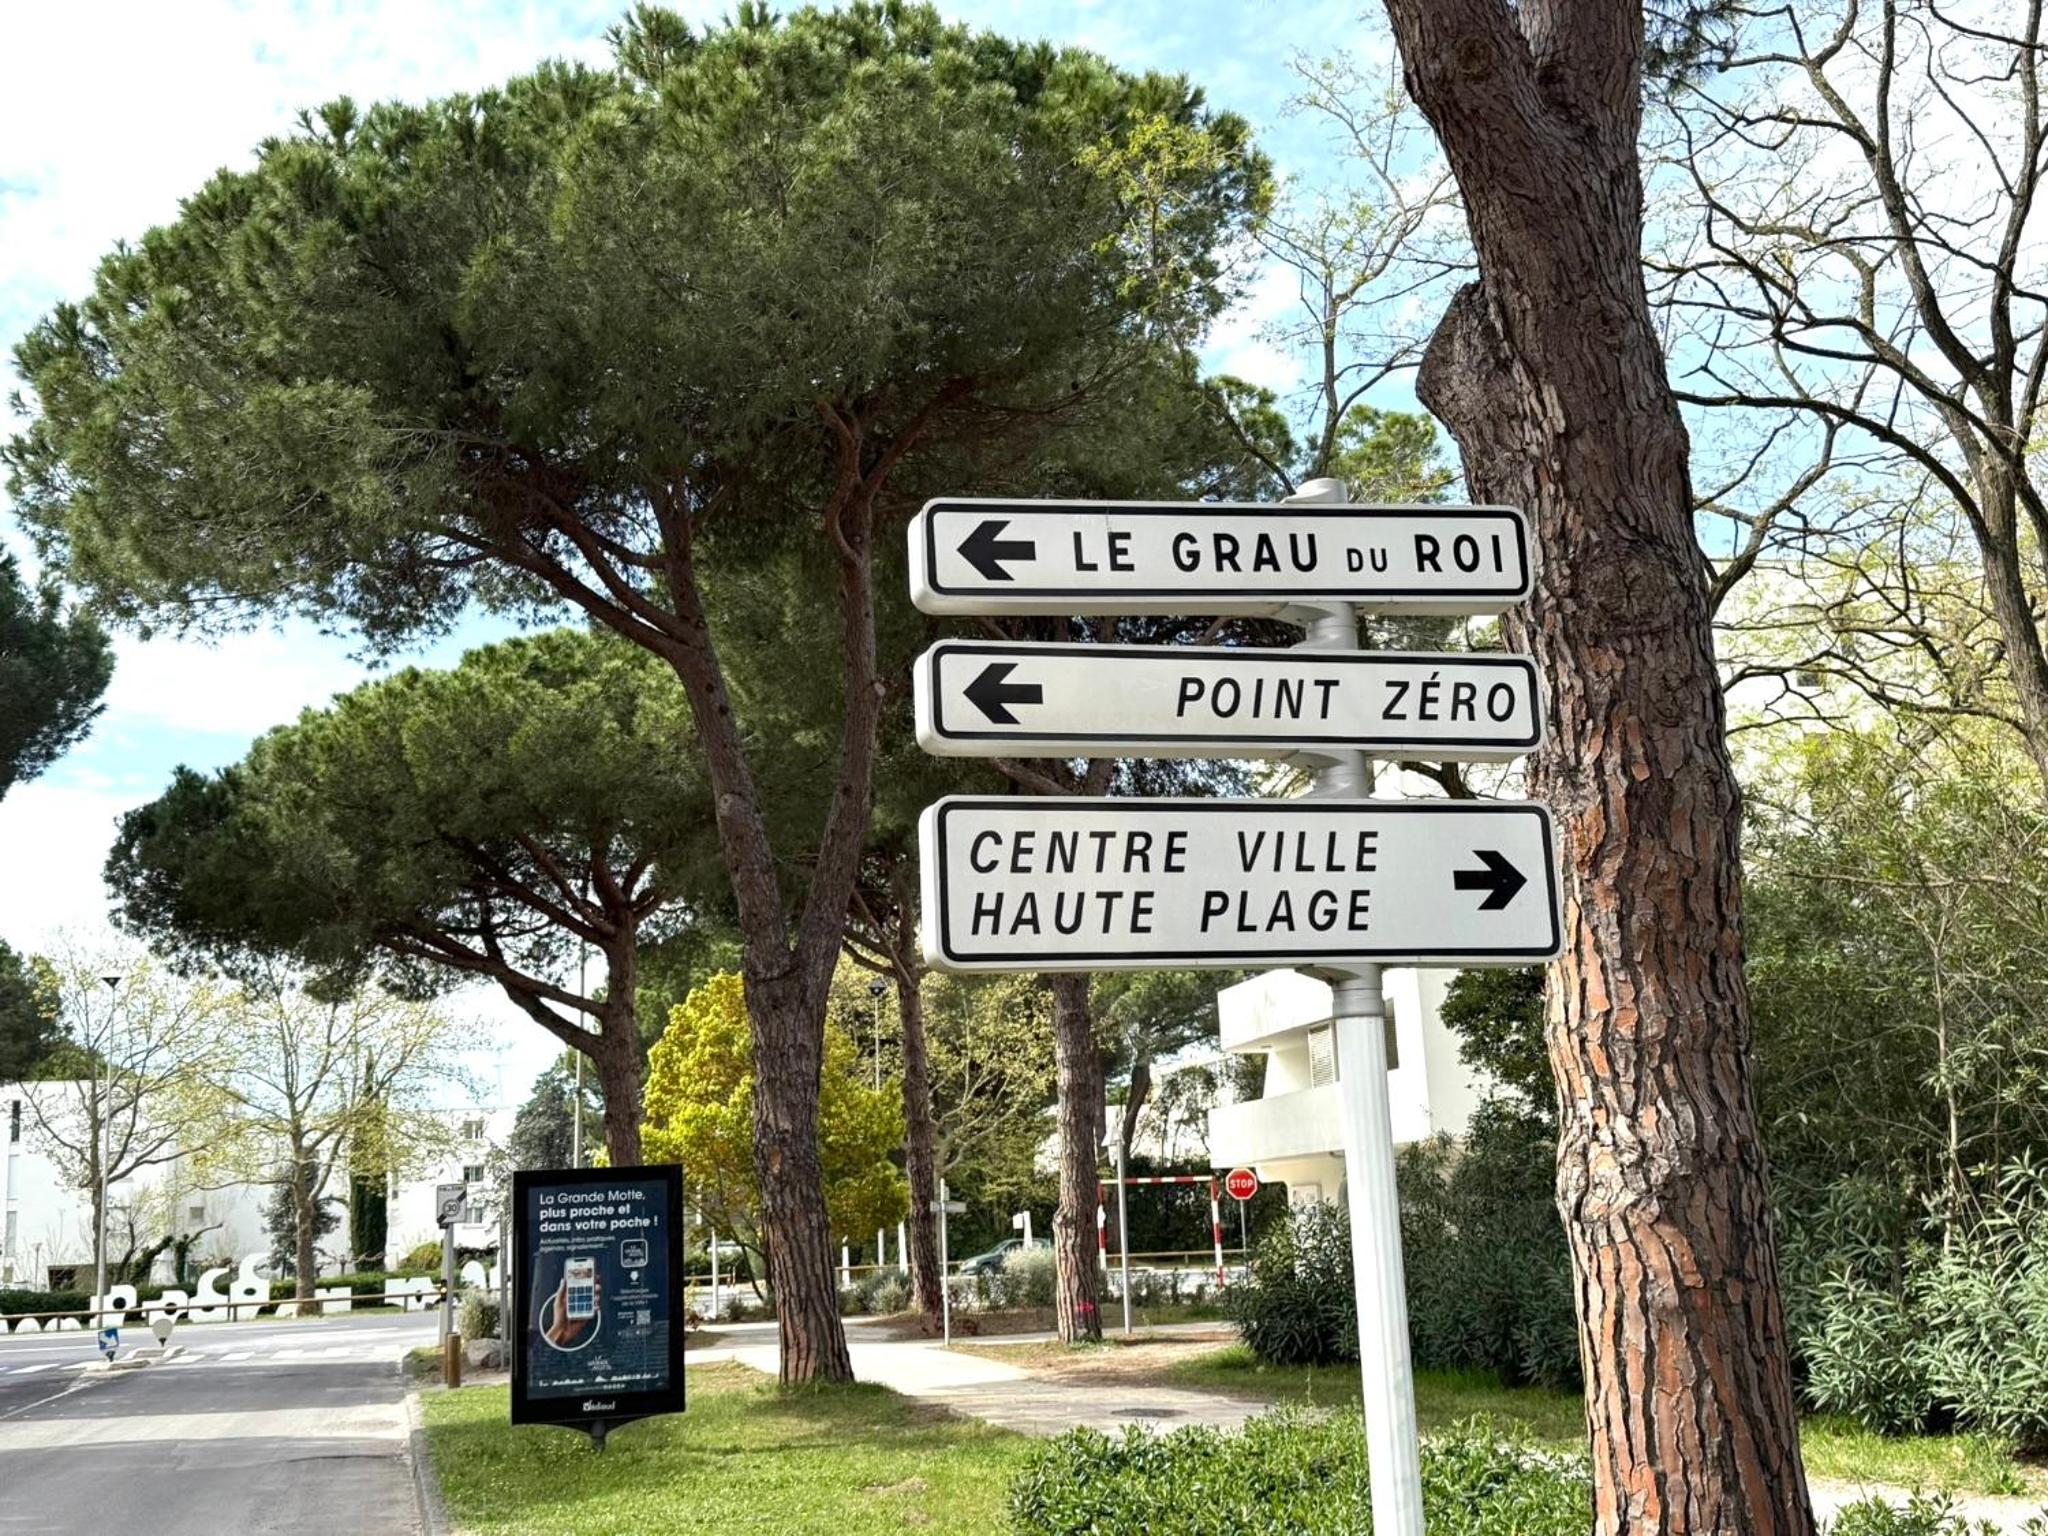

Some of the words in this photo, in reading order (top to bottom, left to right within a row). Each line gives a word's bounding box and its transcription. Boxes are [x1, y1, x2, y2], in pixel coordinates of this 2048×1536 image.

[1073, 531, 1135, 572] LE
[1172, 532, 1318, 573] GRAU
[1347, 547, 1389, 573] DU
[1414, 534, 1504, 573] ROI
[1176, 676, 1340, 719] POINT
[1382, 671, 1516, 722] ZÉRO
[970, 830, 1189, 874] CENTRE
[1237, 830, 1379, 873] VILLE
[971, 890, 1155, 935] HAUTE
[1200, 889, 1372, 932] PLAGE
[540, 1193, 554, 1205] La
[557, 1191, 605, 1204] Grande
[1229, 1179, 1254, 1189] STOP
[540, 1207, 566, 1220] plus
[570, 1204, 615, 1219] proche
[618, 1203, 631, 1214] et
[540, 1221, 571, 1233] dans
[575, 1219, 607, 1230] votre
[610, 1216, 651, 1231] poche
[654, 1215, 659, 1226] !
